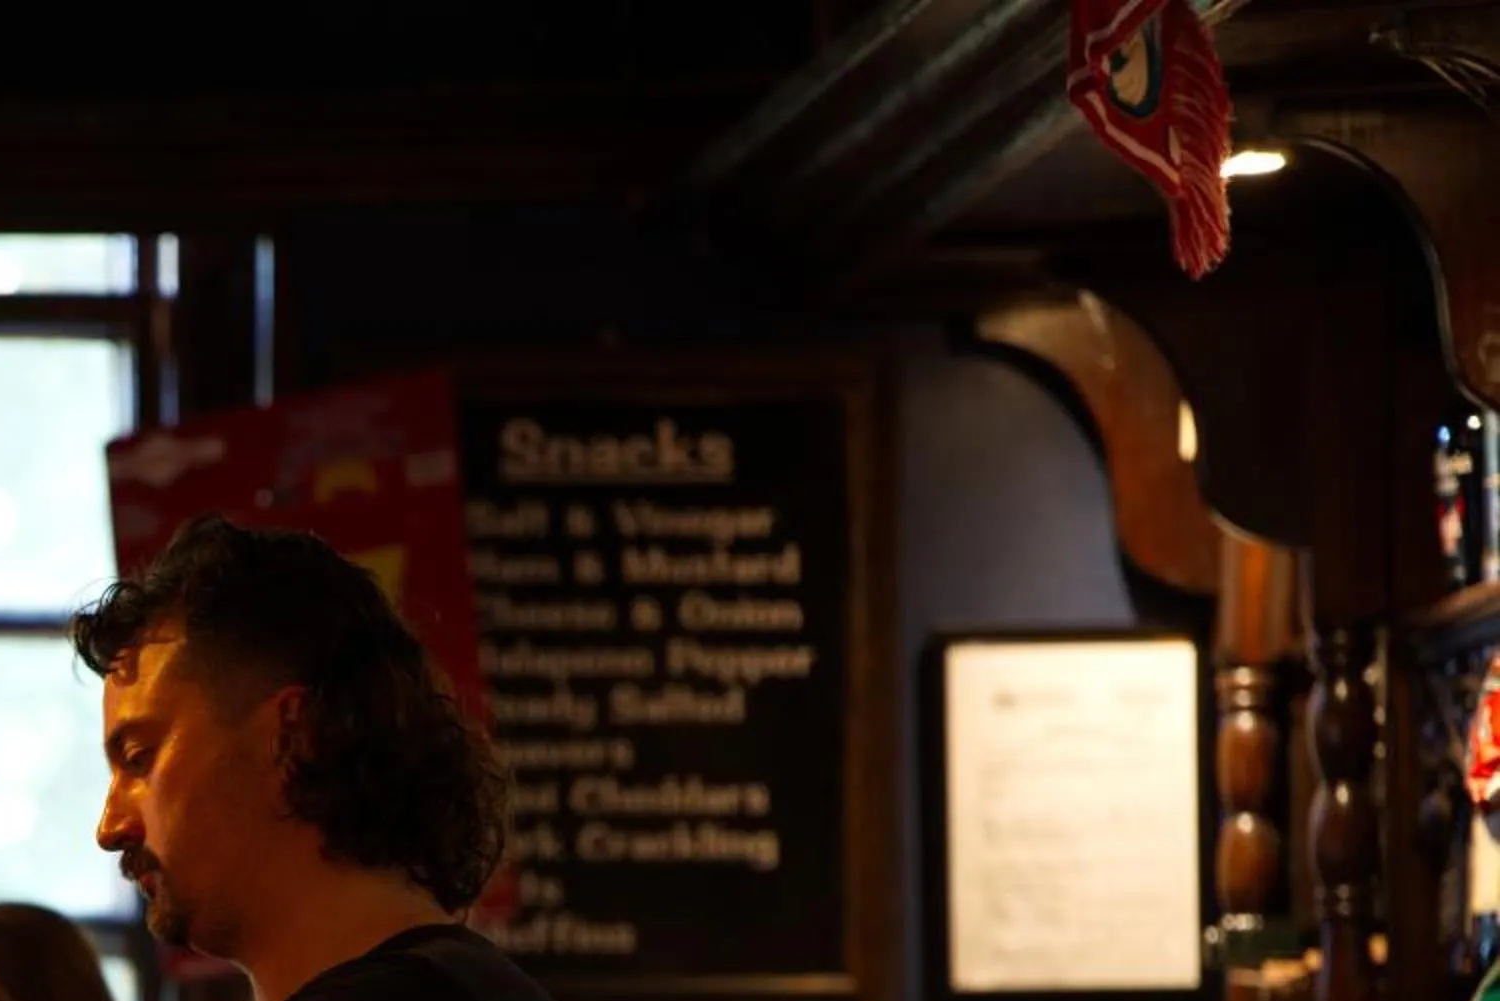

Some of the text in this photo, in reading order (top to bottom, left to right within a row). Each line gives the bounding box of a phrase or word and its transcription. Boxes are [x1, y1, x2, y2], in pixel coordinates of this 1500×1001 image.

[498, 416, 735, 476] Snacks
[565, 502, 596, 538] &
[610, 498, 776, 546] Vinegar
[574, 550, 607, 585] &
[622, 541, 801, 584] Mustard
[630, 594, 663, 632] &
[678, 590, 803, 632] Onion
[665, 637, 817, 684] Pepper
[610, 682, 745, 724] Salted
[571, 773, 769, 816] Cheddars
[577, 822, 780, 872] Crackling
